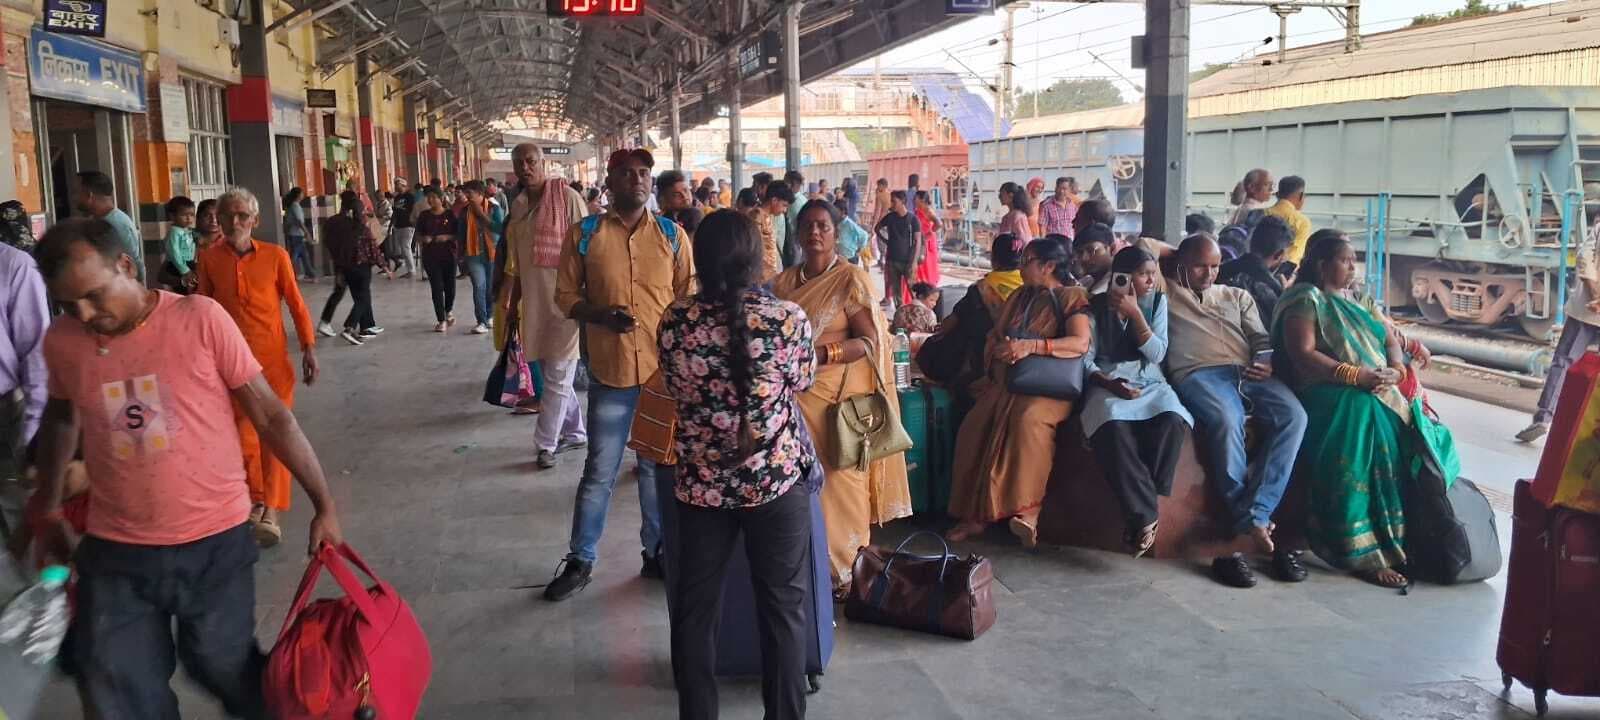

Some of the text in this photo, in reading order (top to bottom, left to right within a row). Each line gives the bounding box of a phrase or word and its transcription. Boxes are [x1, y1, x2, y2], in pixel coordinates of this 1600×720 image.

[48, 18, 99, 30] EXIT
[49, 9, 99, 22] बाहर
[100, 57, 139, 96] EXIT
[126, 404, 144, 430] S
